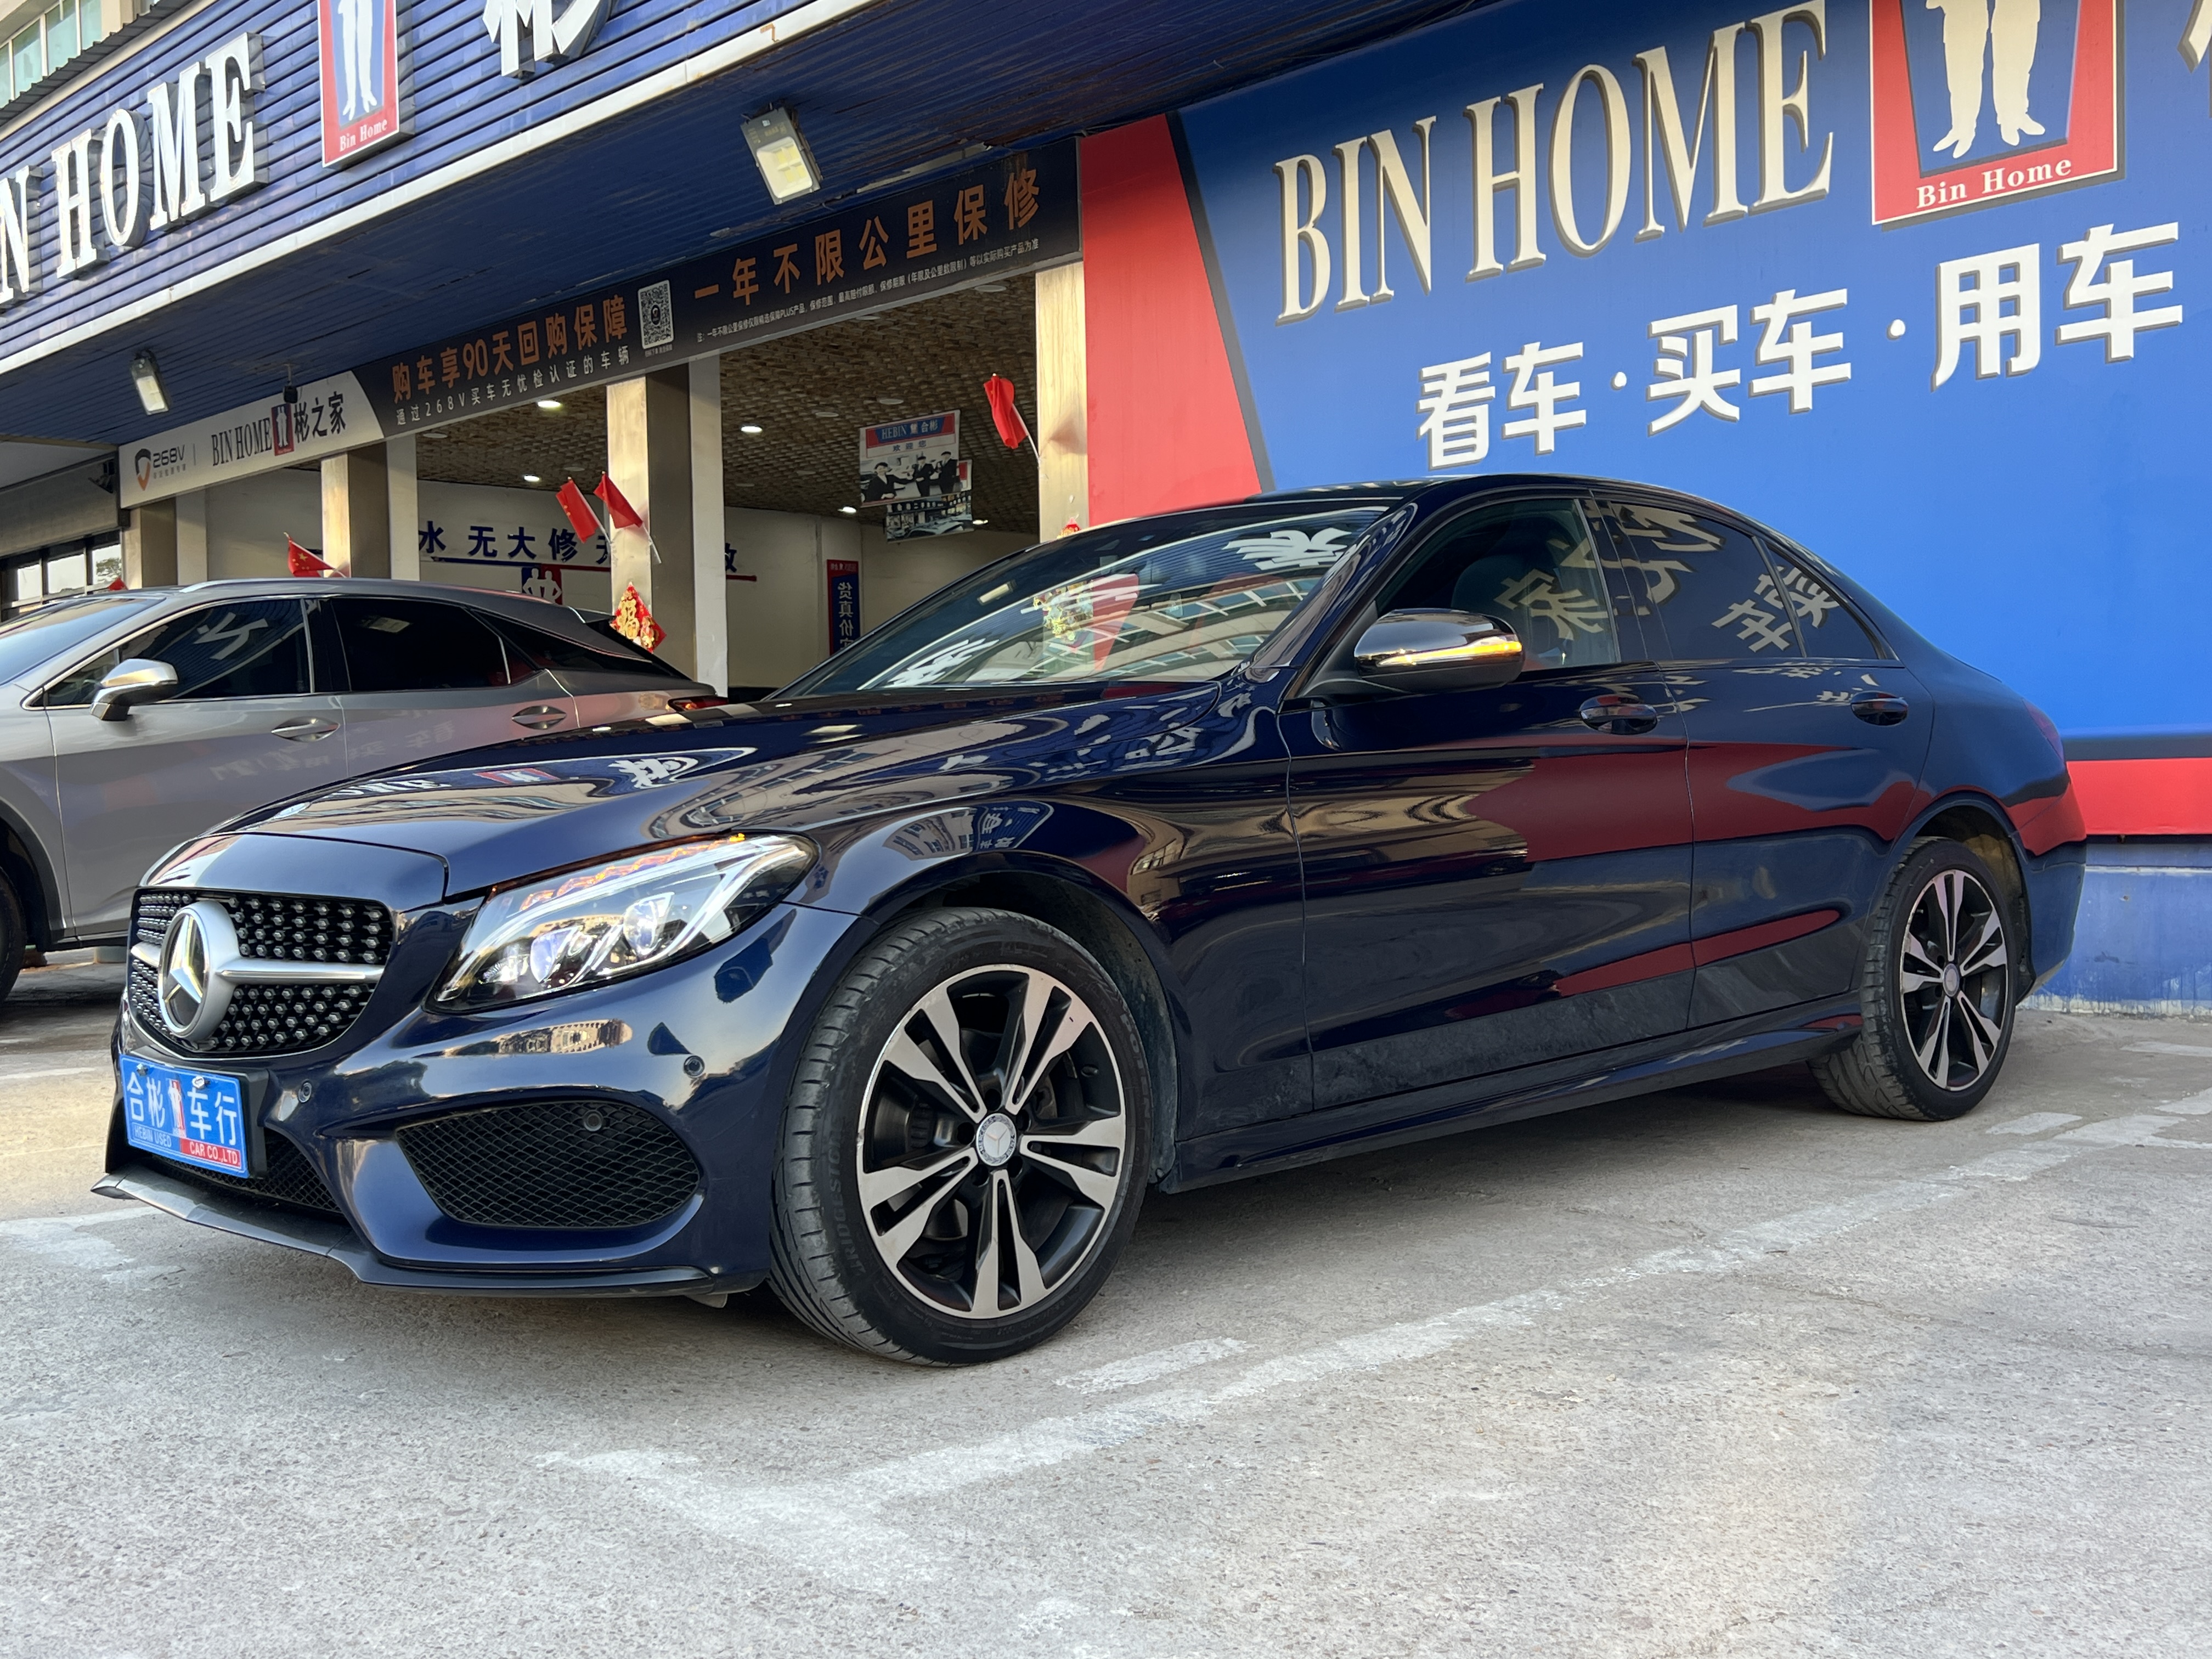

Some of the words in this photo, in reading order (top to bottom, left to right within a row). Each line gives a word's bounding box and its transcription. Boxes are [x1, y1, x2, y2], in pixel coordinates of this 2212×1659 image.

[51, 32, 256, 279] HOME
[340, 133, 356, 152] Bin
[360, 119, 387, 142] Home
[1273, 115, 1436, 325] BIN
[1464, 1, 1833, 283] HOME
[1916, 181, 1967, 209] Bin
[1982, 159, 2072, 194] Home
[694, 168, 1041, 306] 一年不限公里保修
[392, 294, 629, 404] 购车享90天回购保障
[396, 345, 630, 426] 通过268V买车无忧检认证的车辆
[211, 429, 233, 467] BIN
[235, 417, 273, 460] HOME
[294, 391, 346, 444] 彬之家
[881, 424, 907, 440] HEBIN
[153, 444, 185, 469] 268V
[467, 525, 578, 563] 无大修
[127, 1071, 166, 1128] 合彬
[187, 1087, 238, 1146] 车行
[134, 1126, 153, 1140] HEBIN
[154, 1131, 172, 1148] USED
[189, 1141, 206, 1156] CAR
